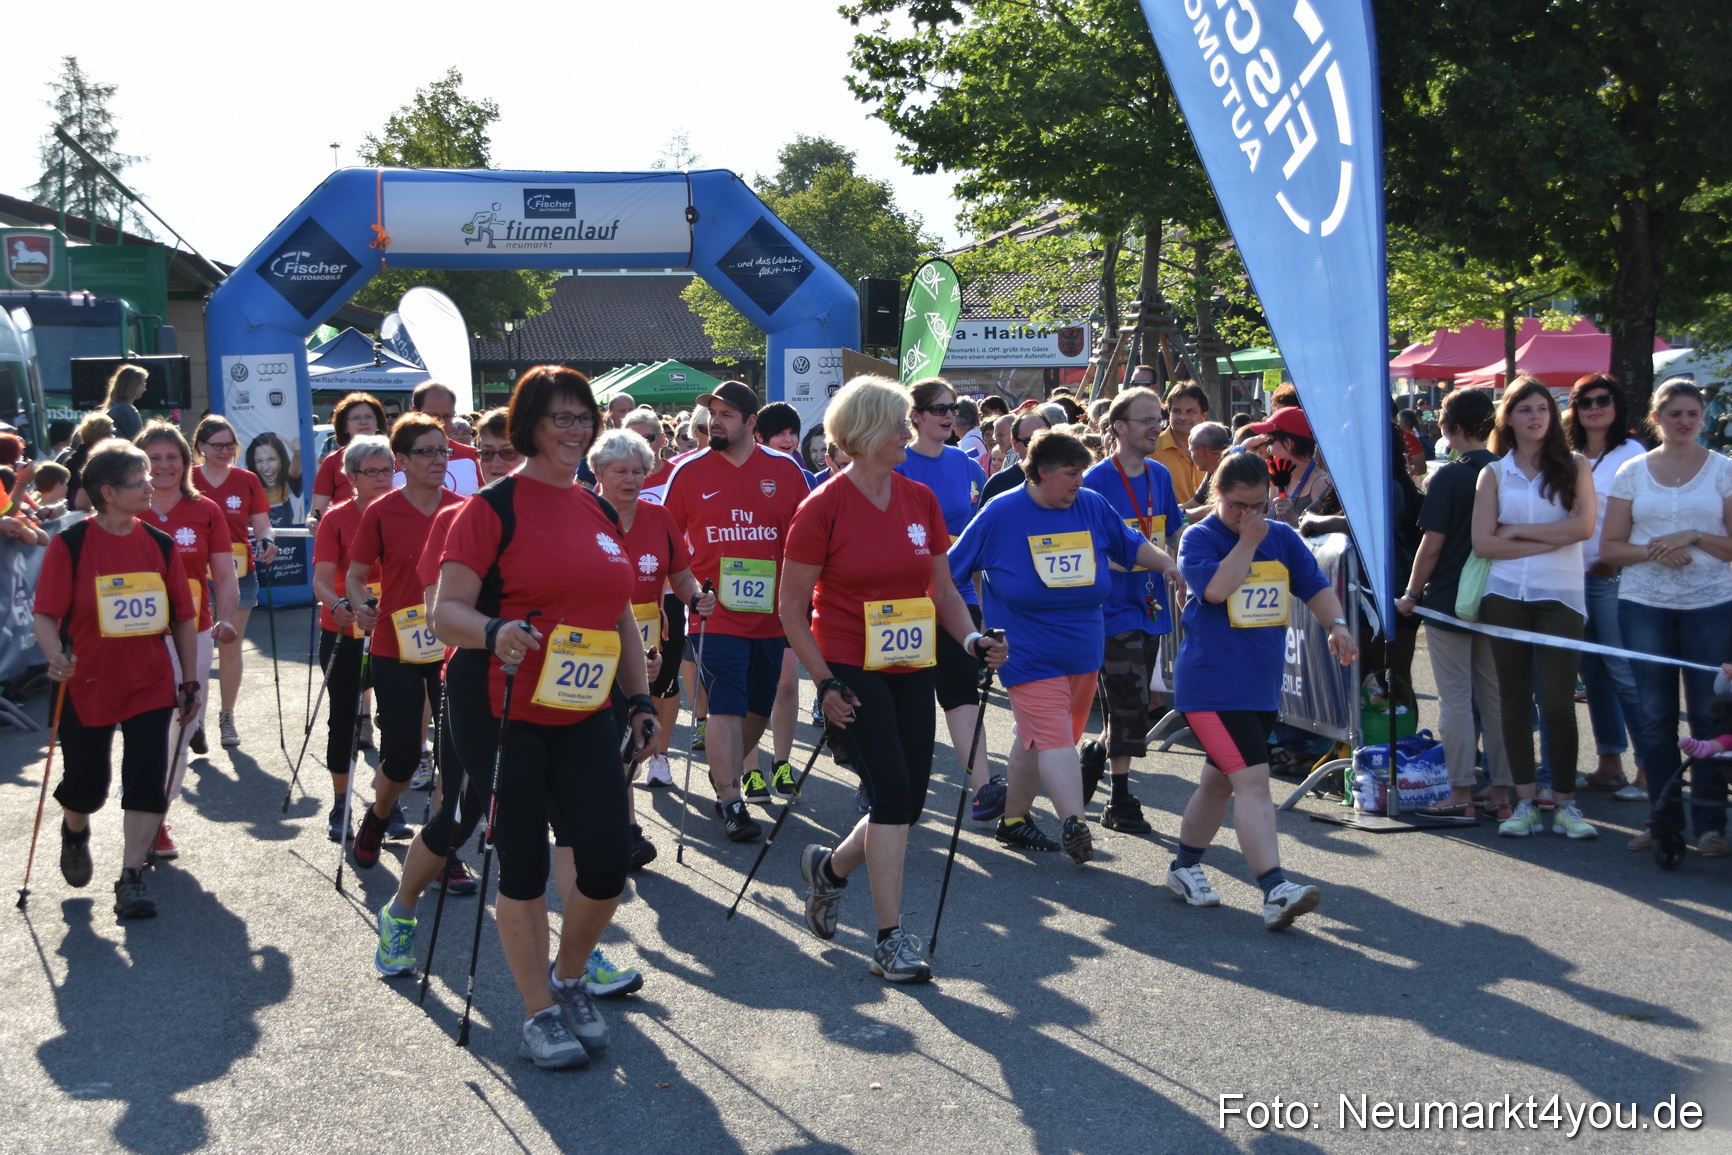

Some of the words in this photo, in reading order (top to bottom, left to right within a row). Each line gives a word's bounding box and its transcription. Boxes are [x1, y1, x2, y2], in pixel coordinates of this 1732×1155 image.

[535, 199, 573, 208] Fischer
[506, 220, 620, 241] firmenlauf
[506, 241, 553, 249] neumarkt
[284, 261, 347, 274] Fischer
[755, 256, 771, 265] das
[926, 312, 953, 350] AOK
[901, 339, 928, 382] AOK
[731, 509, 754, 525] Fly
[705, 523, 778, 544] Emirates
[1045, 554, 1082, 574] 757
[732, 579, 766, 599] 162
[1241, 587, 1279, 610] 722
[113, 597, 158, 620] 205
[880, 626, 923, 652] 209
[556, 660, 604, 689] 202
[1280, 672, 1303, 697] BILE
